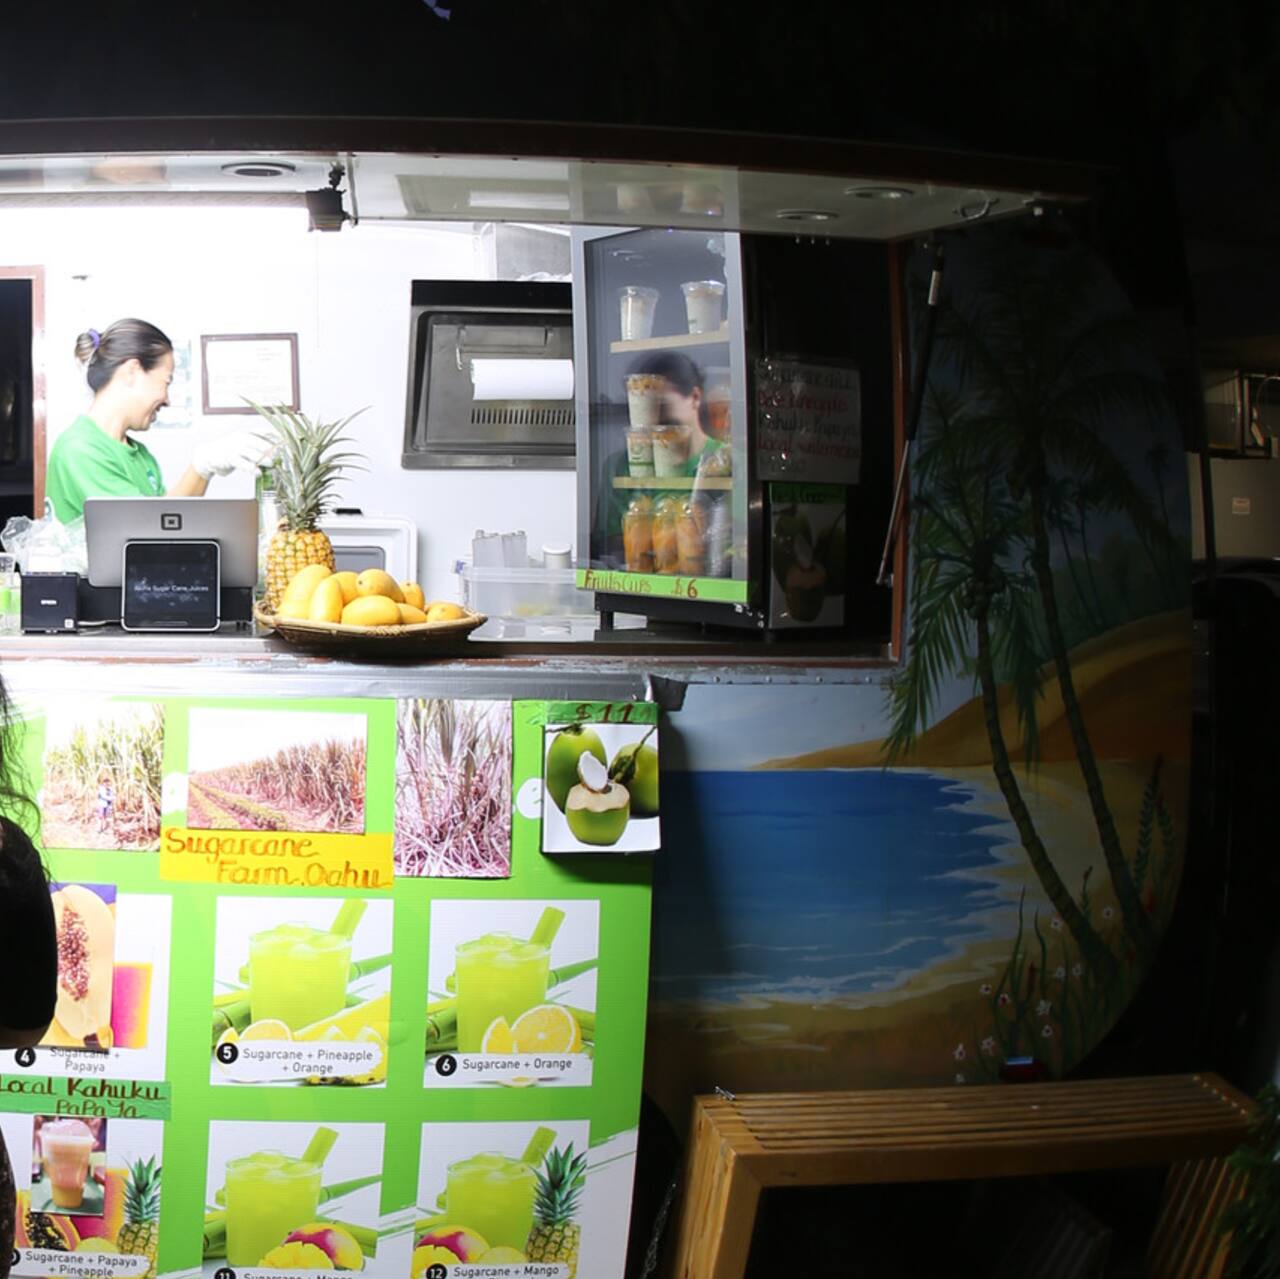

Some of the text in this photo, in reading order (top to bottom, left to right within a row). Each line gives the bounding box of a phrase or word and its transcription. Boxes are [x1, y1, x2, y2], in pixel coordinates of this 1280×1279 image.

[166, 827, 319, 864] Sugarcane
[306, 861, 393, 889] Oahu
[242, 1048, 303, 1064] Sugarcane
[317, 1049, 374, 1064] Pineapple
[64, 1059, 106, 1074] Papaya
[292, 1062, 334, 1075] Orange
[462, 1058, 521, 1072] Sugarcane
[534, 1057, 573, 1071] Orange
[67, 1077, 167, 1101] Kahuku
[25, 1251, 84, 1266] Sugarcane
[97, 1255, 138, 1269] Papaya
[59, 1264, 114, 1278] Pineapple
[453, 1267, 511, 1279] Sugarcane
[523, 1265, 560, 1278] Mango
